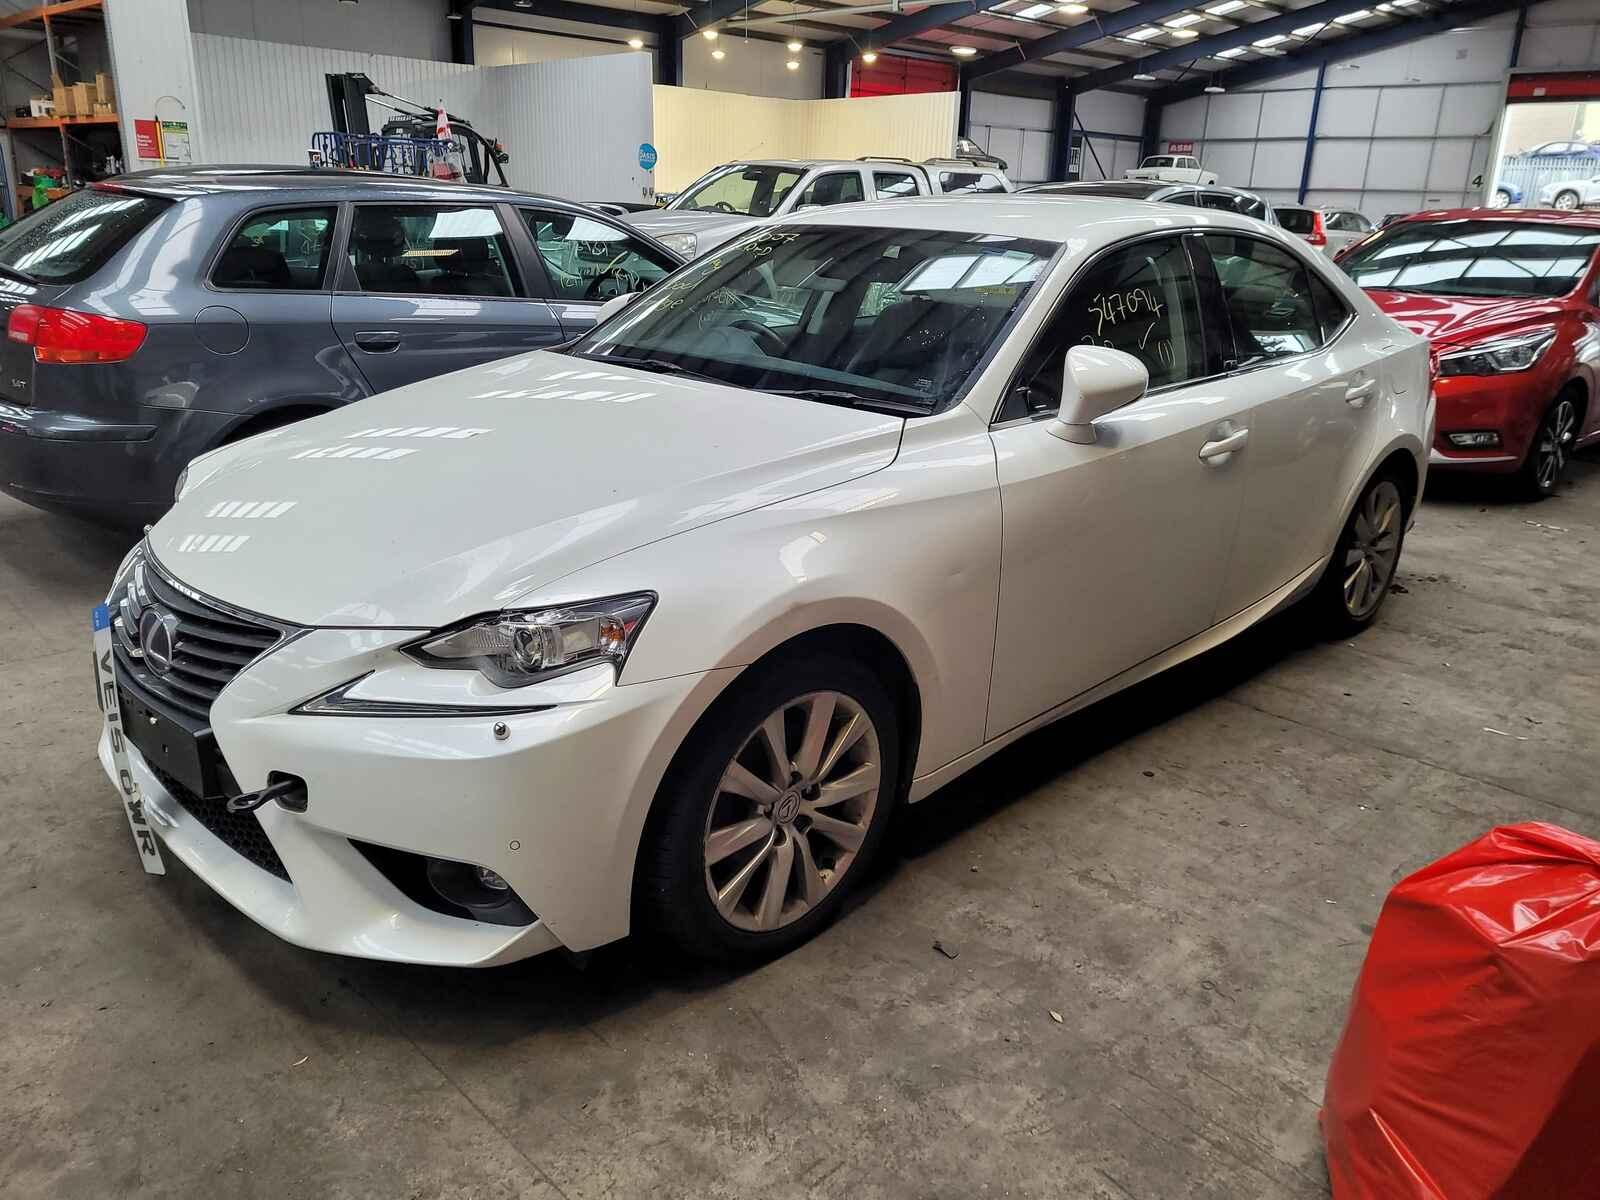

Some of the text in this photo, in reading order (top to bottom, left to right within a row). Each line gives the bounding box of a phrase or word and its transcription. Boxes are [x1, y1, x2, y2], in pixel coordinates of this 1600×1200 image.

[1472, 175, 1484, 188] 4
[1088, 288, 1164, 336] 547094
[119, 767, 157, 858] OWR
